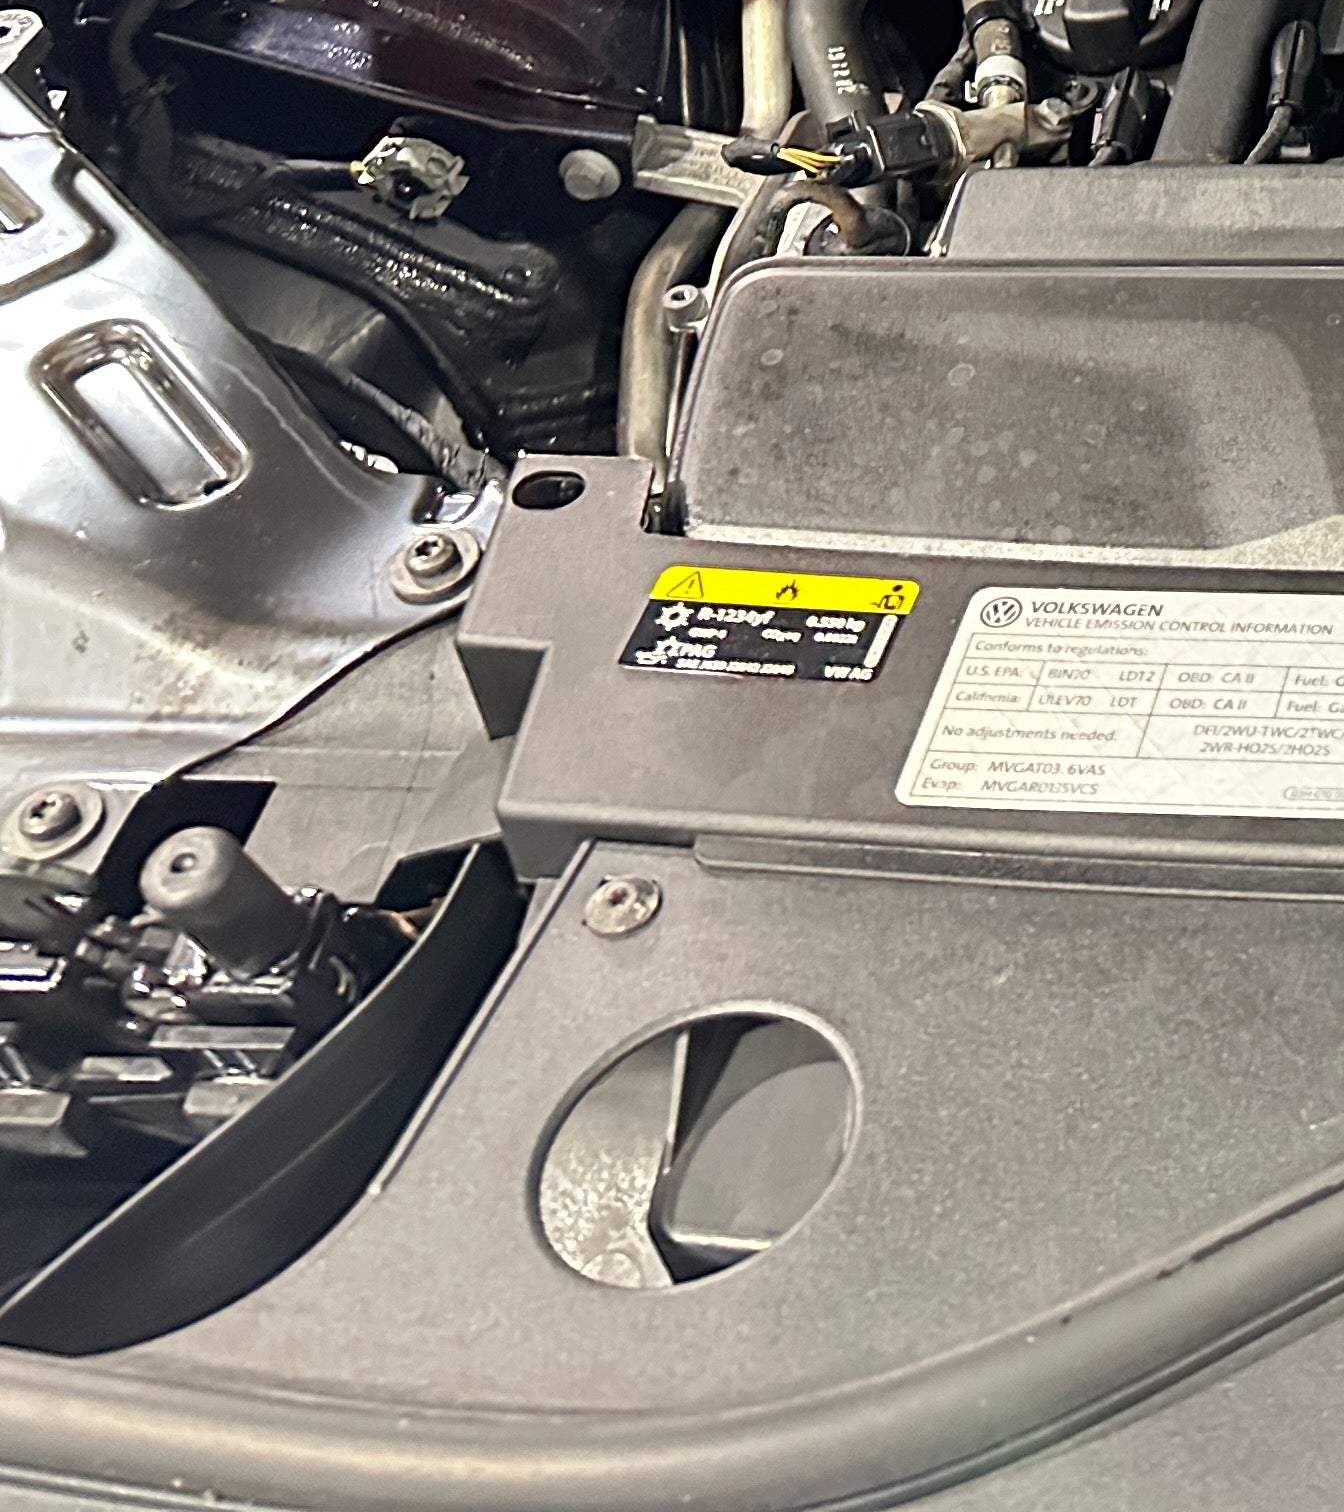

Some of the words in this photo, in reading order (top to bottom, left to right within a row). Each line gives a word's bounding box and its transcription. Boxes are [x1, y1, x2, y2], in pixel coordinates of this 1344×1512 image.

[1032, 601, 1164, 617] VOLKSWAGEN
[1026, 617, 1080, 629] VEHICLE
[1086, 619, 1156, 630] EMISSION
[1159, 621, 1226, 633] CONTROL
[1230, 623, 1334, 635] INFORMATION
[976, 640, 1042, 652] Conforms
[1047, 642, 1062, 653] to
[1221, 673, 1241, 683] CA
[1214, 699, 1234, 709] CA
[942, 725, 963, 736] No
[967, 727, 1056, 740] adjustments
